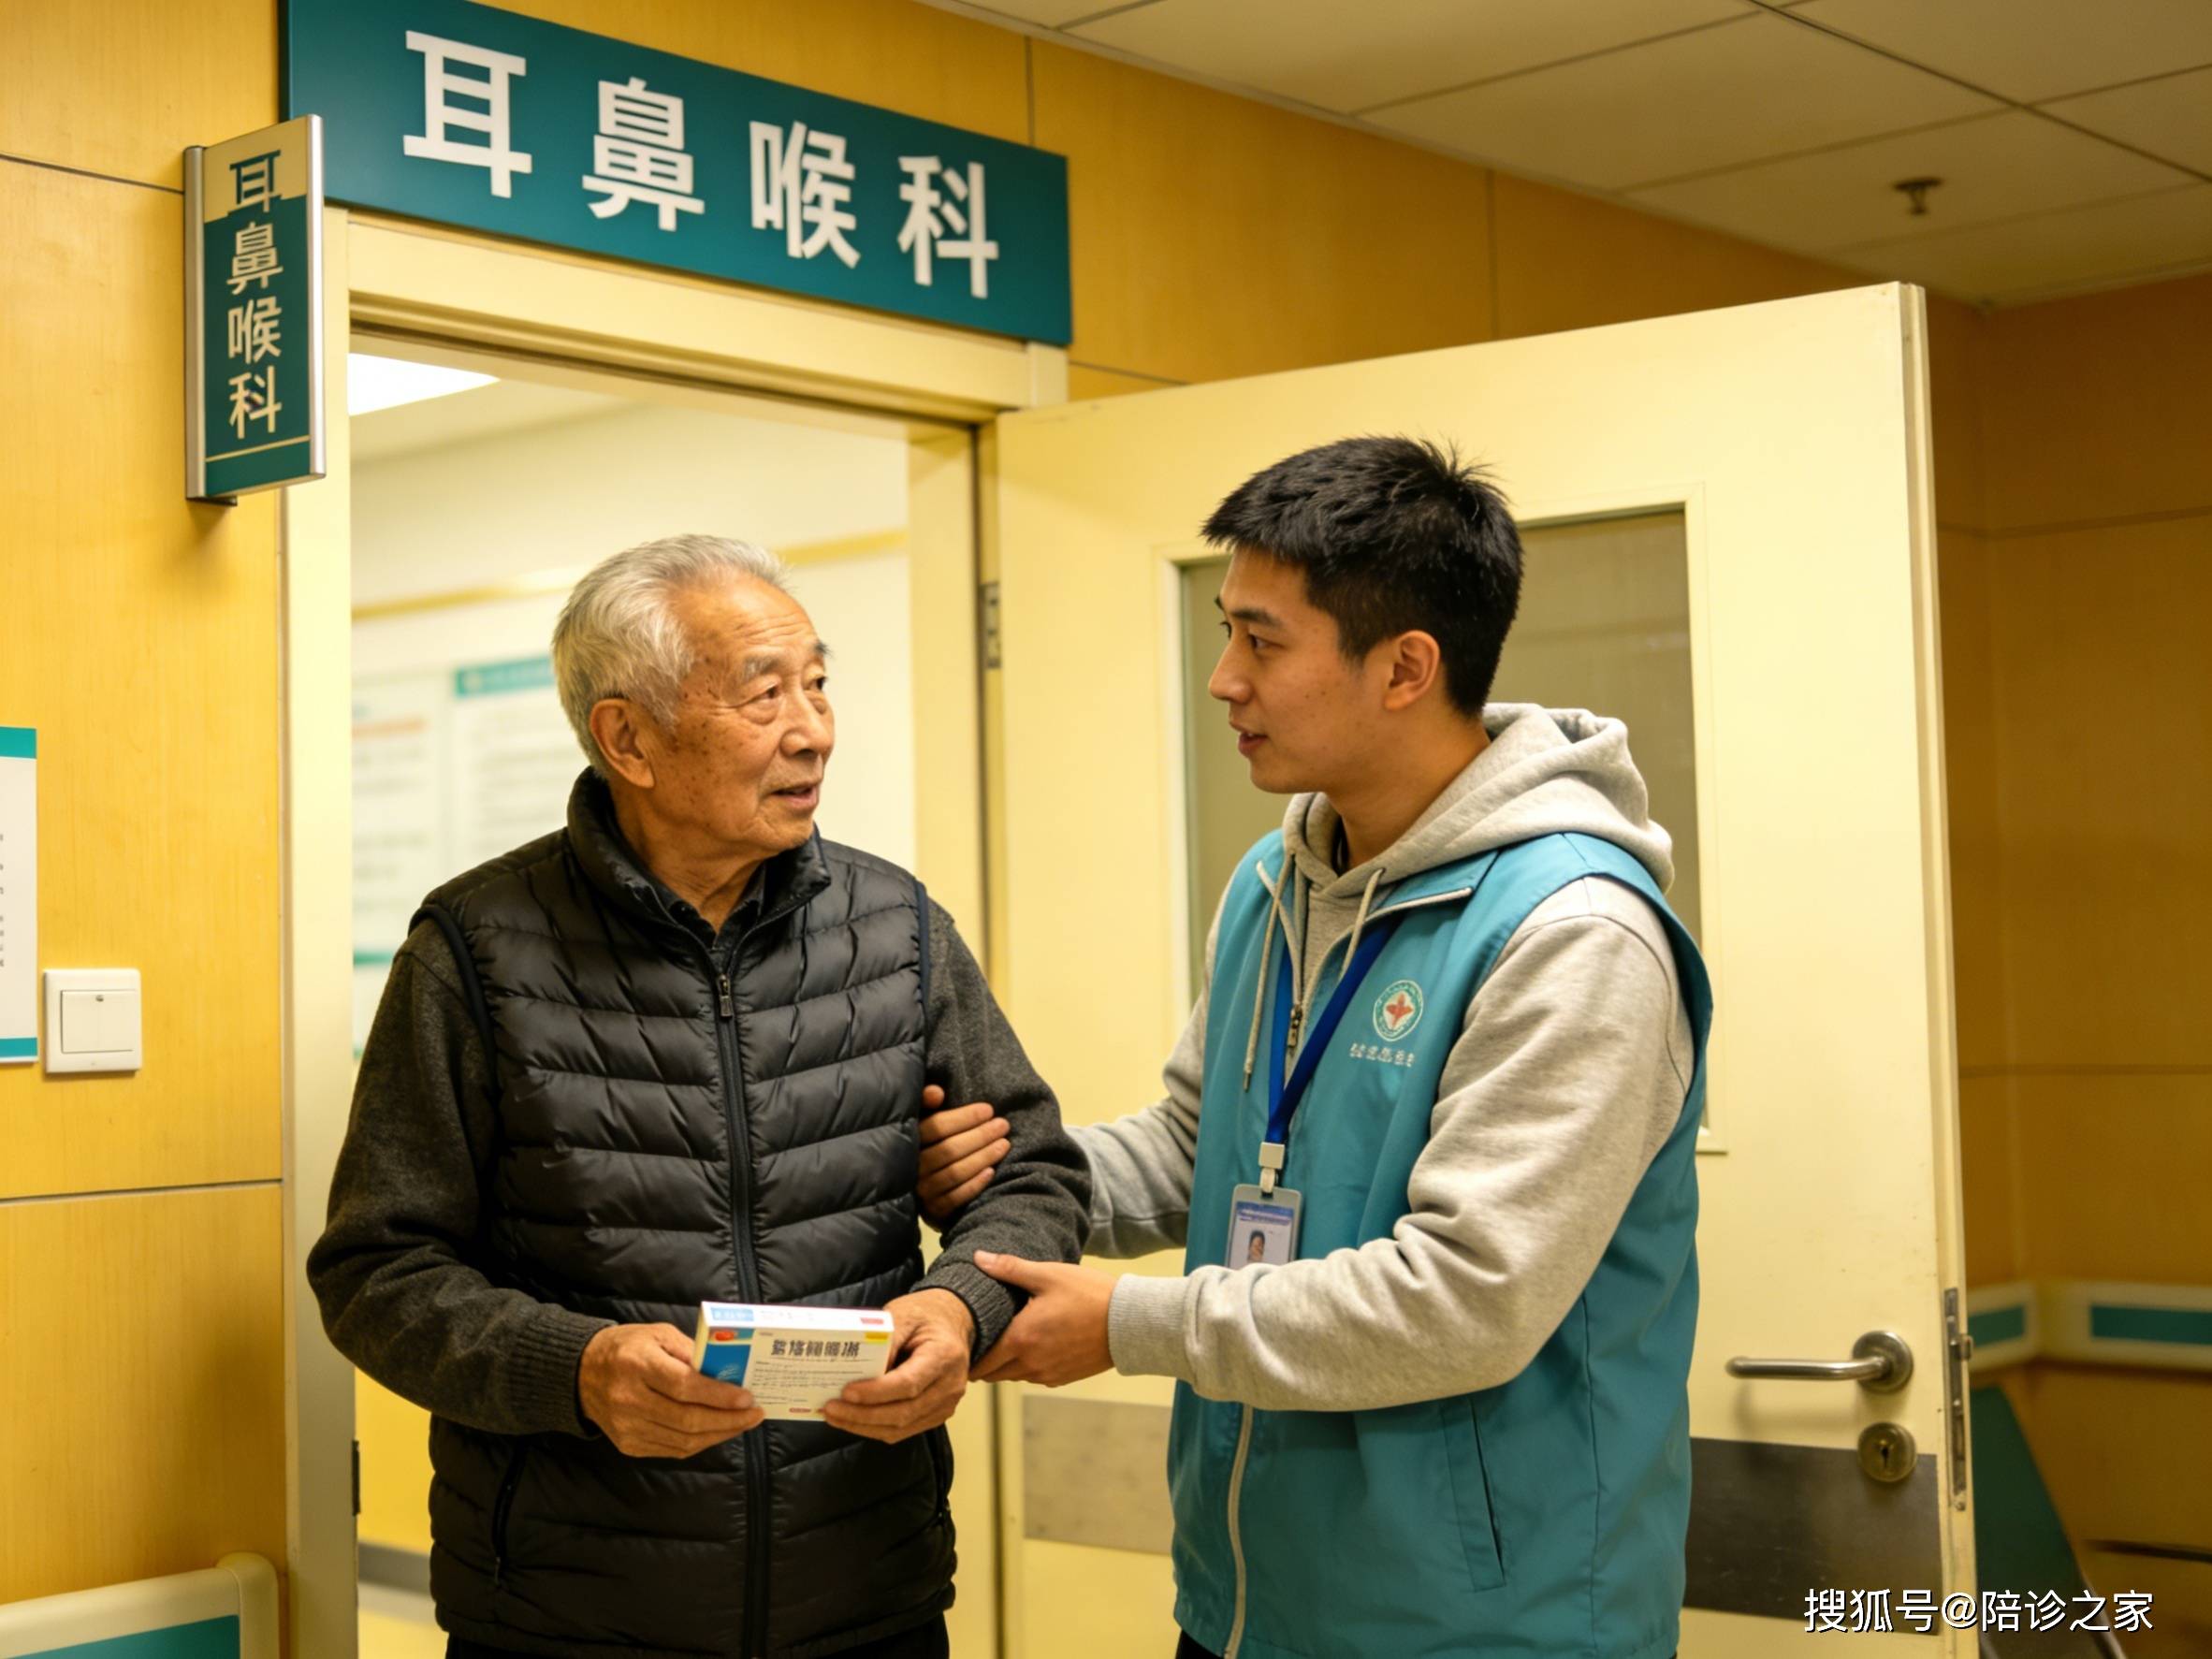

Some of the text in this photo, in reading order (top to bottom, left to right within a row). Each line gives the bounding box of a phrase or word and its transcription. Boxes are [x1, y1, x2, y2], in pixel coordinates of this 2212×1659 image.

[226, 148, 284, 440] 耳鼻喉科
[402, 30, 999, 298] 耳鼻喉科
